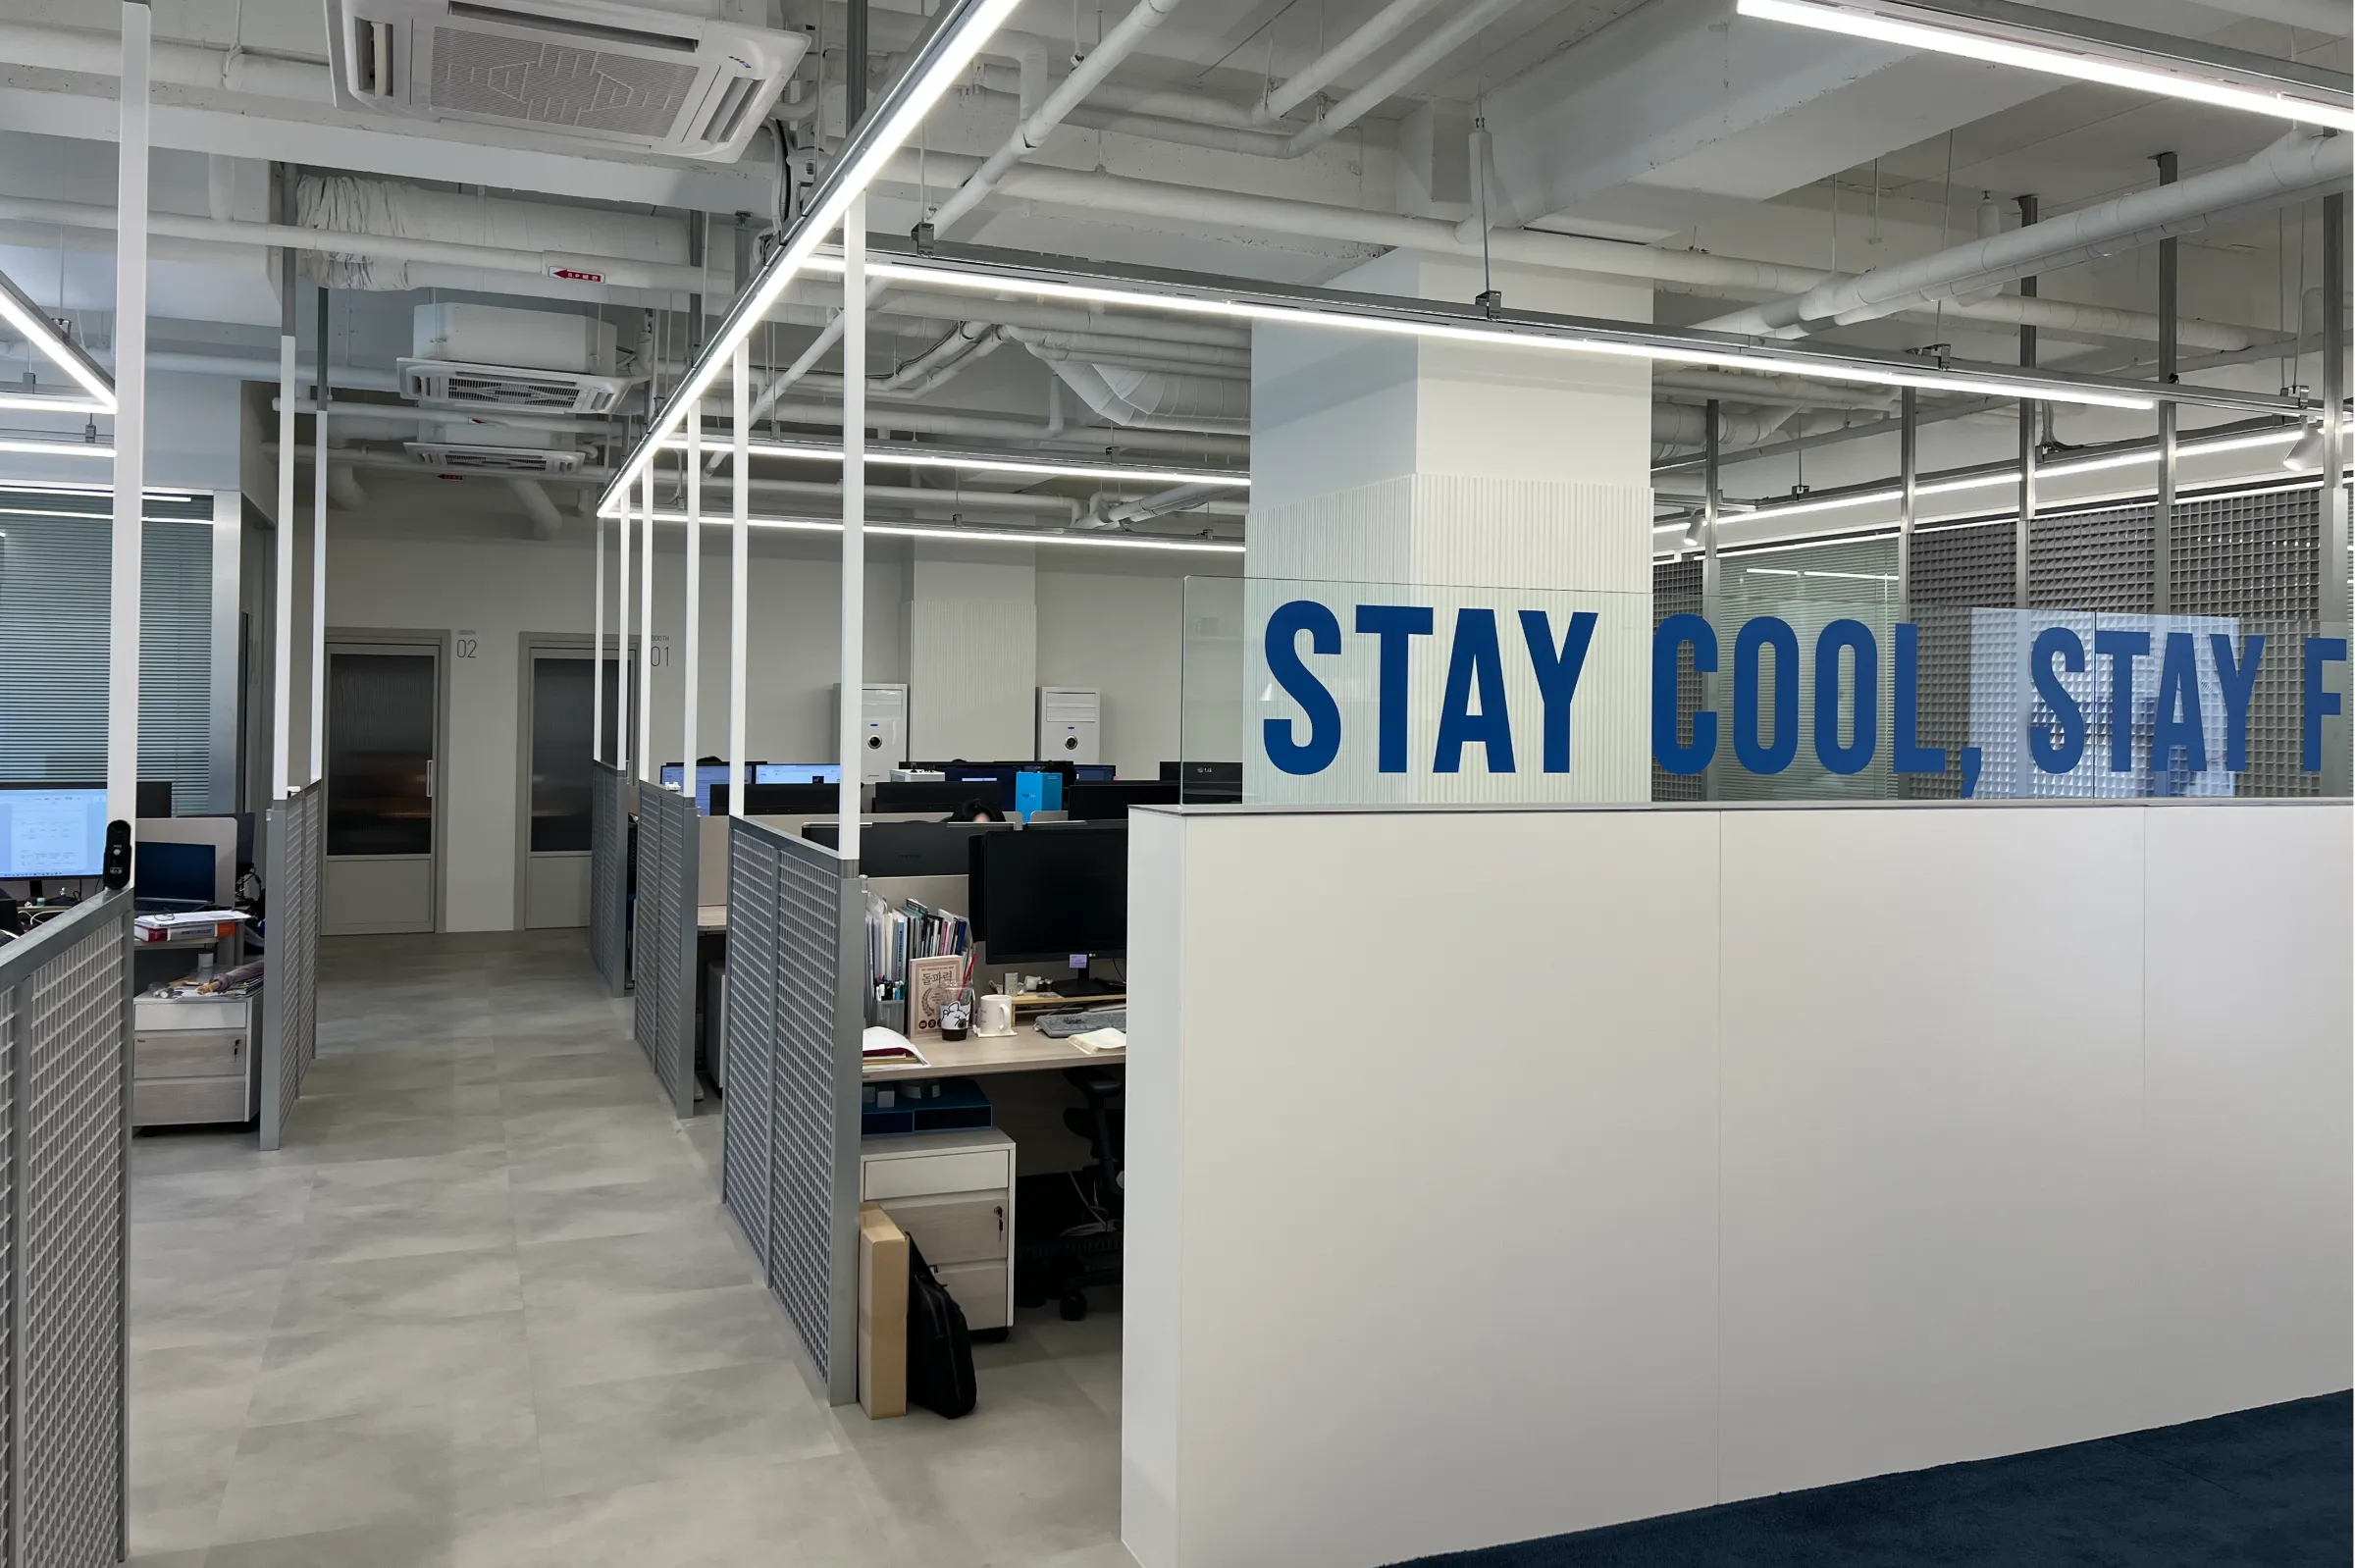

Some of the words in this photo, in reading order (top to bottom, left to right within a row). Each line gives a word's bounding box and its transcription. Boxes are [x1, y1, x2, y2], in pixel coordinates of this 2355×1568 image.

[457, 639, 477, 658] 02
[651, 646, 669, 667] 01
[1262, 601, 1597, 775] STAY
[1652, 613, 1982, 798] COOL,
[2029, 626, 2266, 774] STAY
